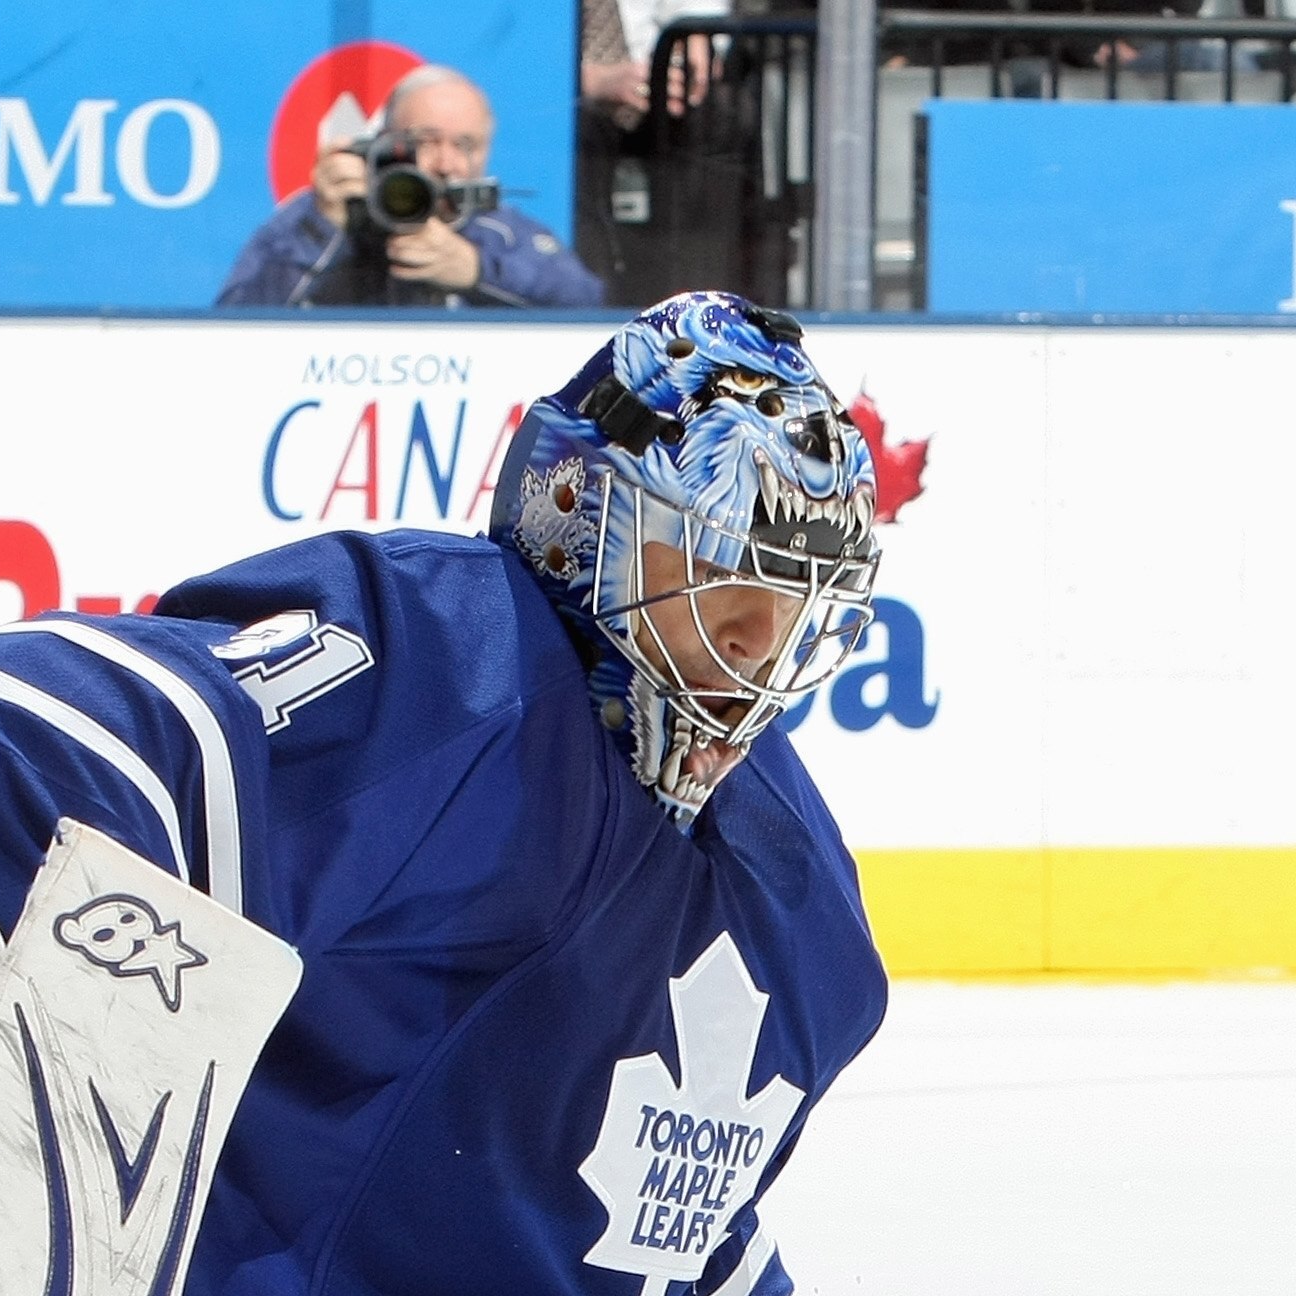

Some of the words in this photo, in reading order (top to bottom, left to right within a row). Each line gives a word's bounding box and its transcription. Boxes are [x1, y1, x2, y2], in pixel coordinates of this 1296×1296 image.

[302, 354, 472, 385] MOLSON
[635, 1104, 764, 1168] TORONTO
[638, 1156, 736, 1210] MAPLE
[630, 1202, 715, 1255] LEAFS
